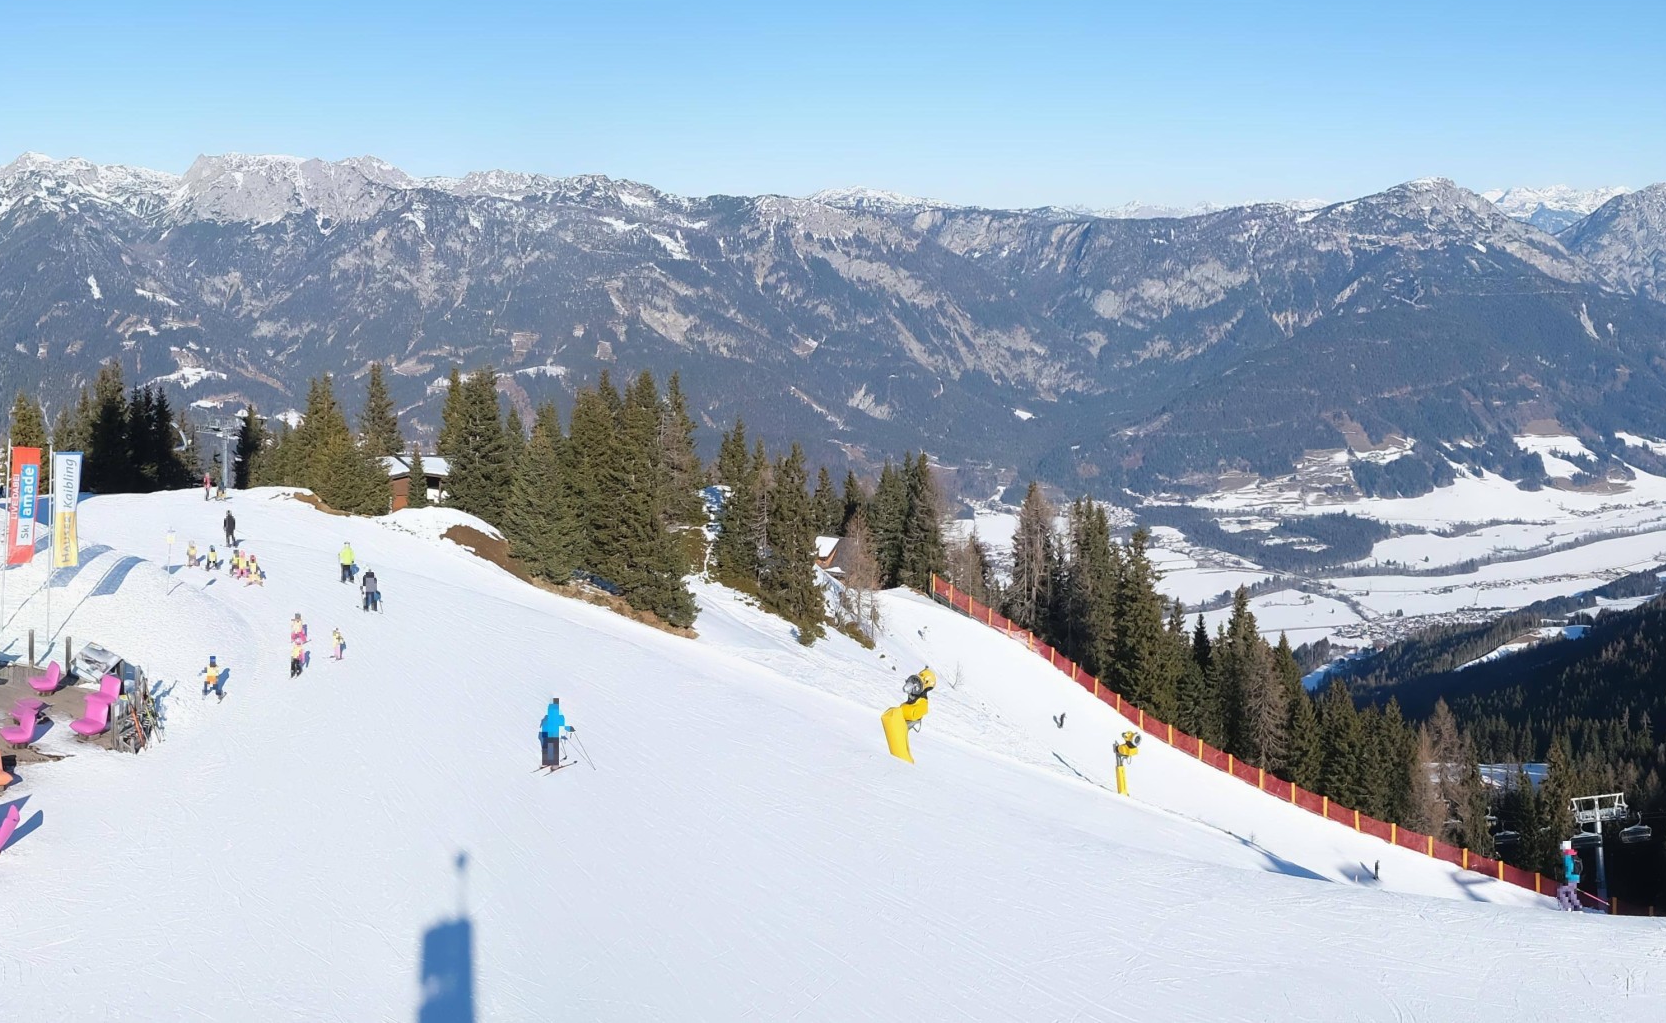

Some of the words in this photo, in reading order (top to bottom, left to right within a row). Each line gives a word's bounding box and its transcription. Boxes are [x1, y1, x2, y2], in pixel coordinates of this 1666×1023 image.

[12, 473, 20, 499] DABEI
[21, 467, 34, 516] amadé
[63, 458, 77, 508] Kaibling
[11, 500, 19, 519] LIVE
[21, 524, 29, 539] Ski
